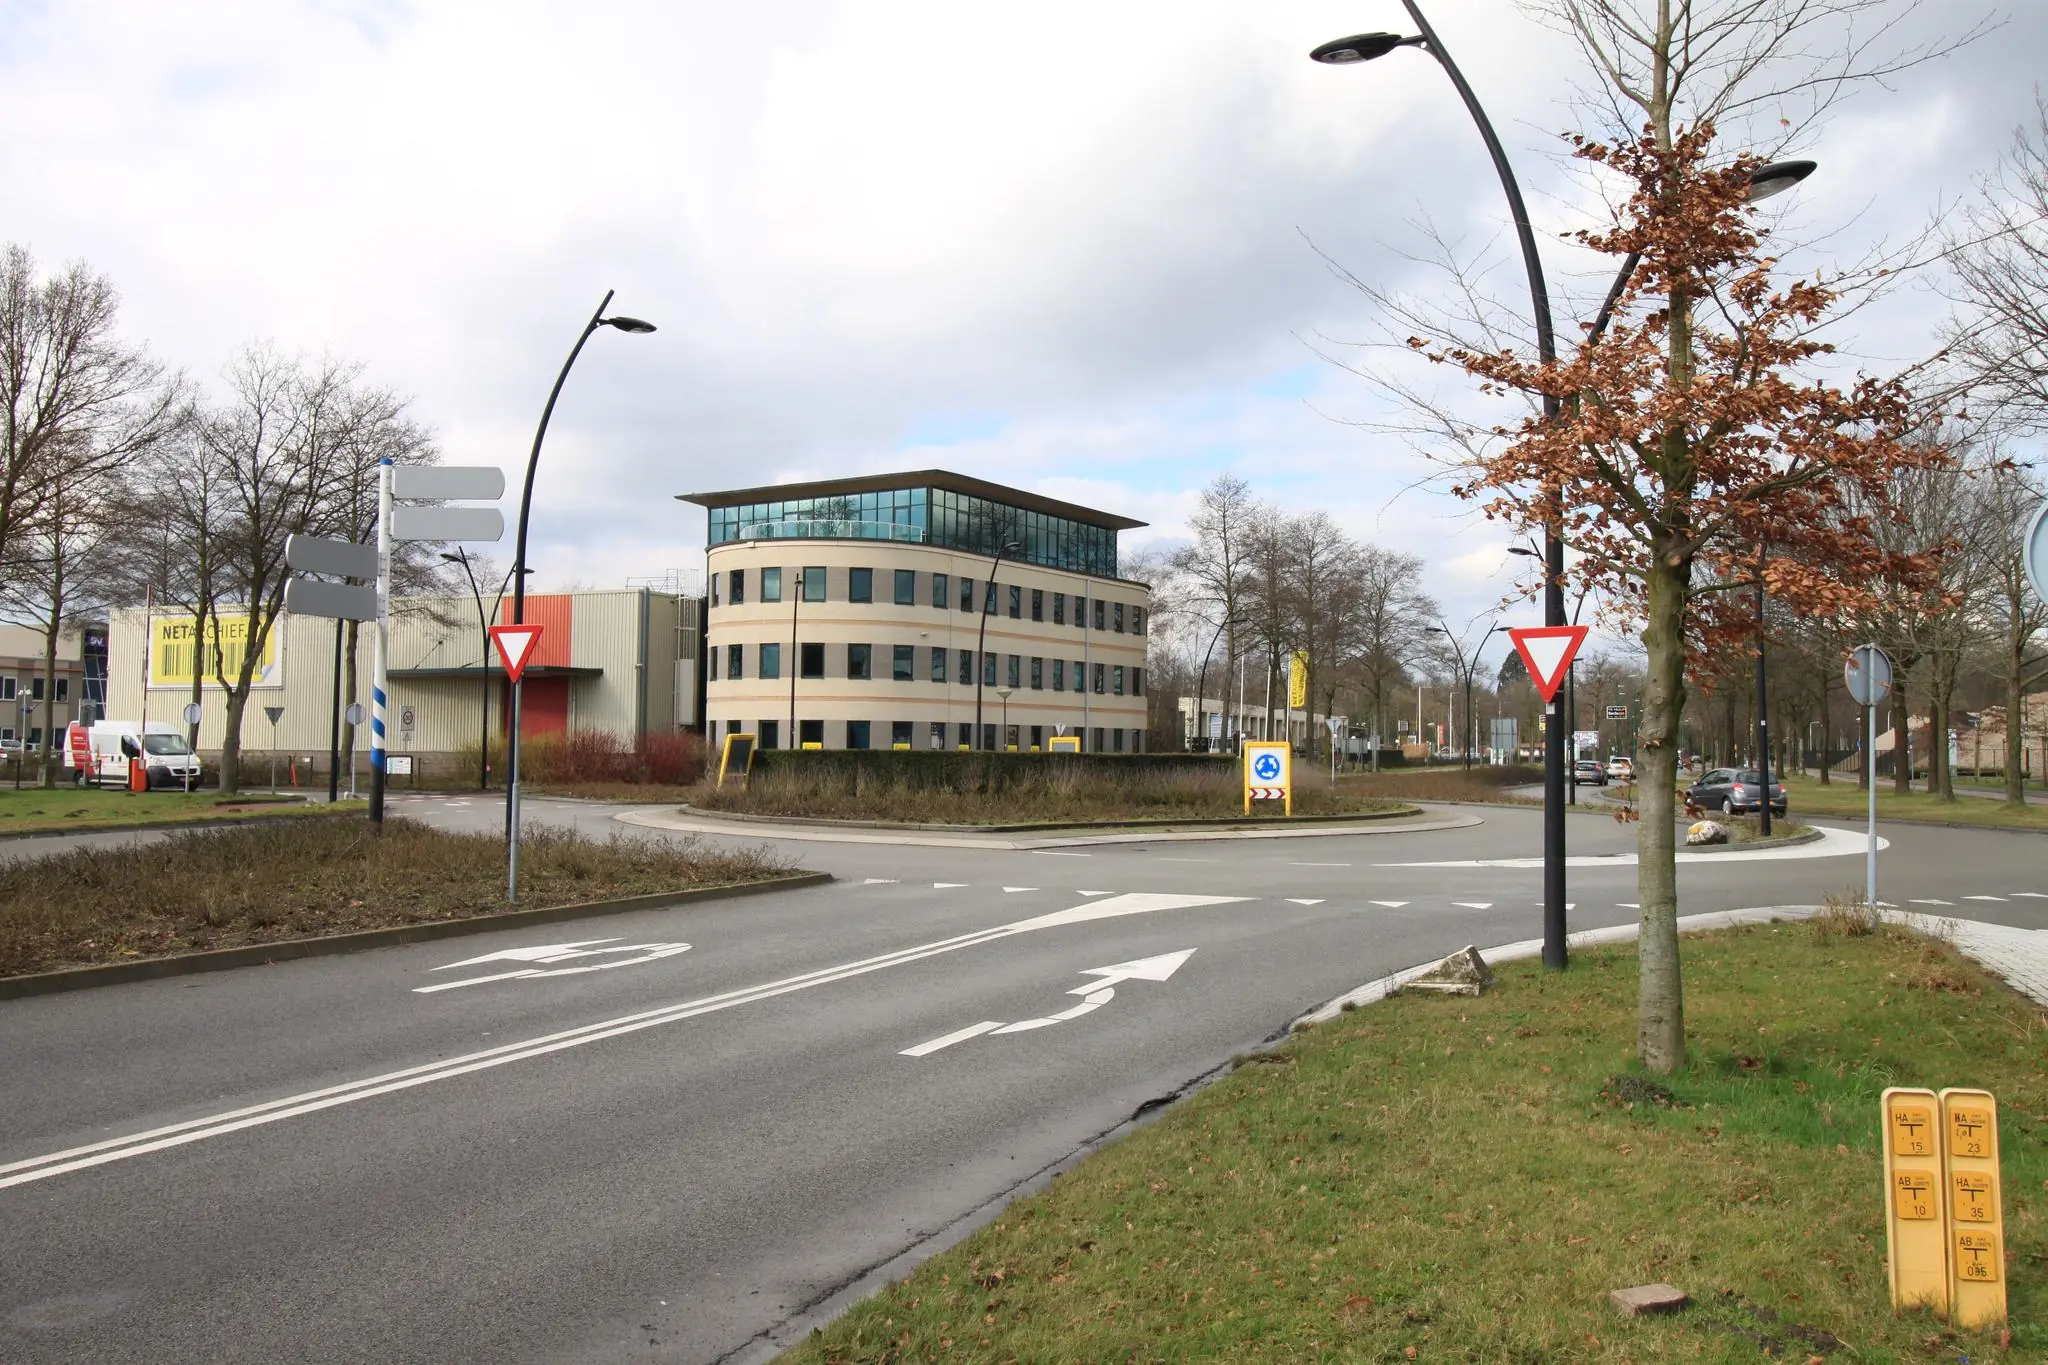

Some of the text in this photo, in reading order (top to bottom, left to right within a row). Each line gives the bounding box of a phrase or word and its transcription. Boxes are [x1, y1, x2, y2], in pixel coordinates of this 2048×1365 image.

[1895, 1113, 1908, 1122] HA
[1911, 1142, 1923, 1151] 15
[1967, 1143, 1980, 1153] 23
[1899, 1177, 1911, 1186] AB
[1956, 1178, 1969, 1187] HA
[1914, 1205, 1926, 1215] 10
[1971, 1208, 1984, 1217] 35
[1960, 1236, 1972, 1246] AB
